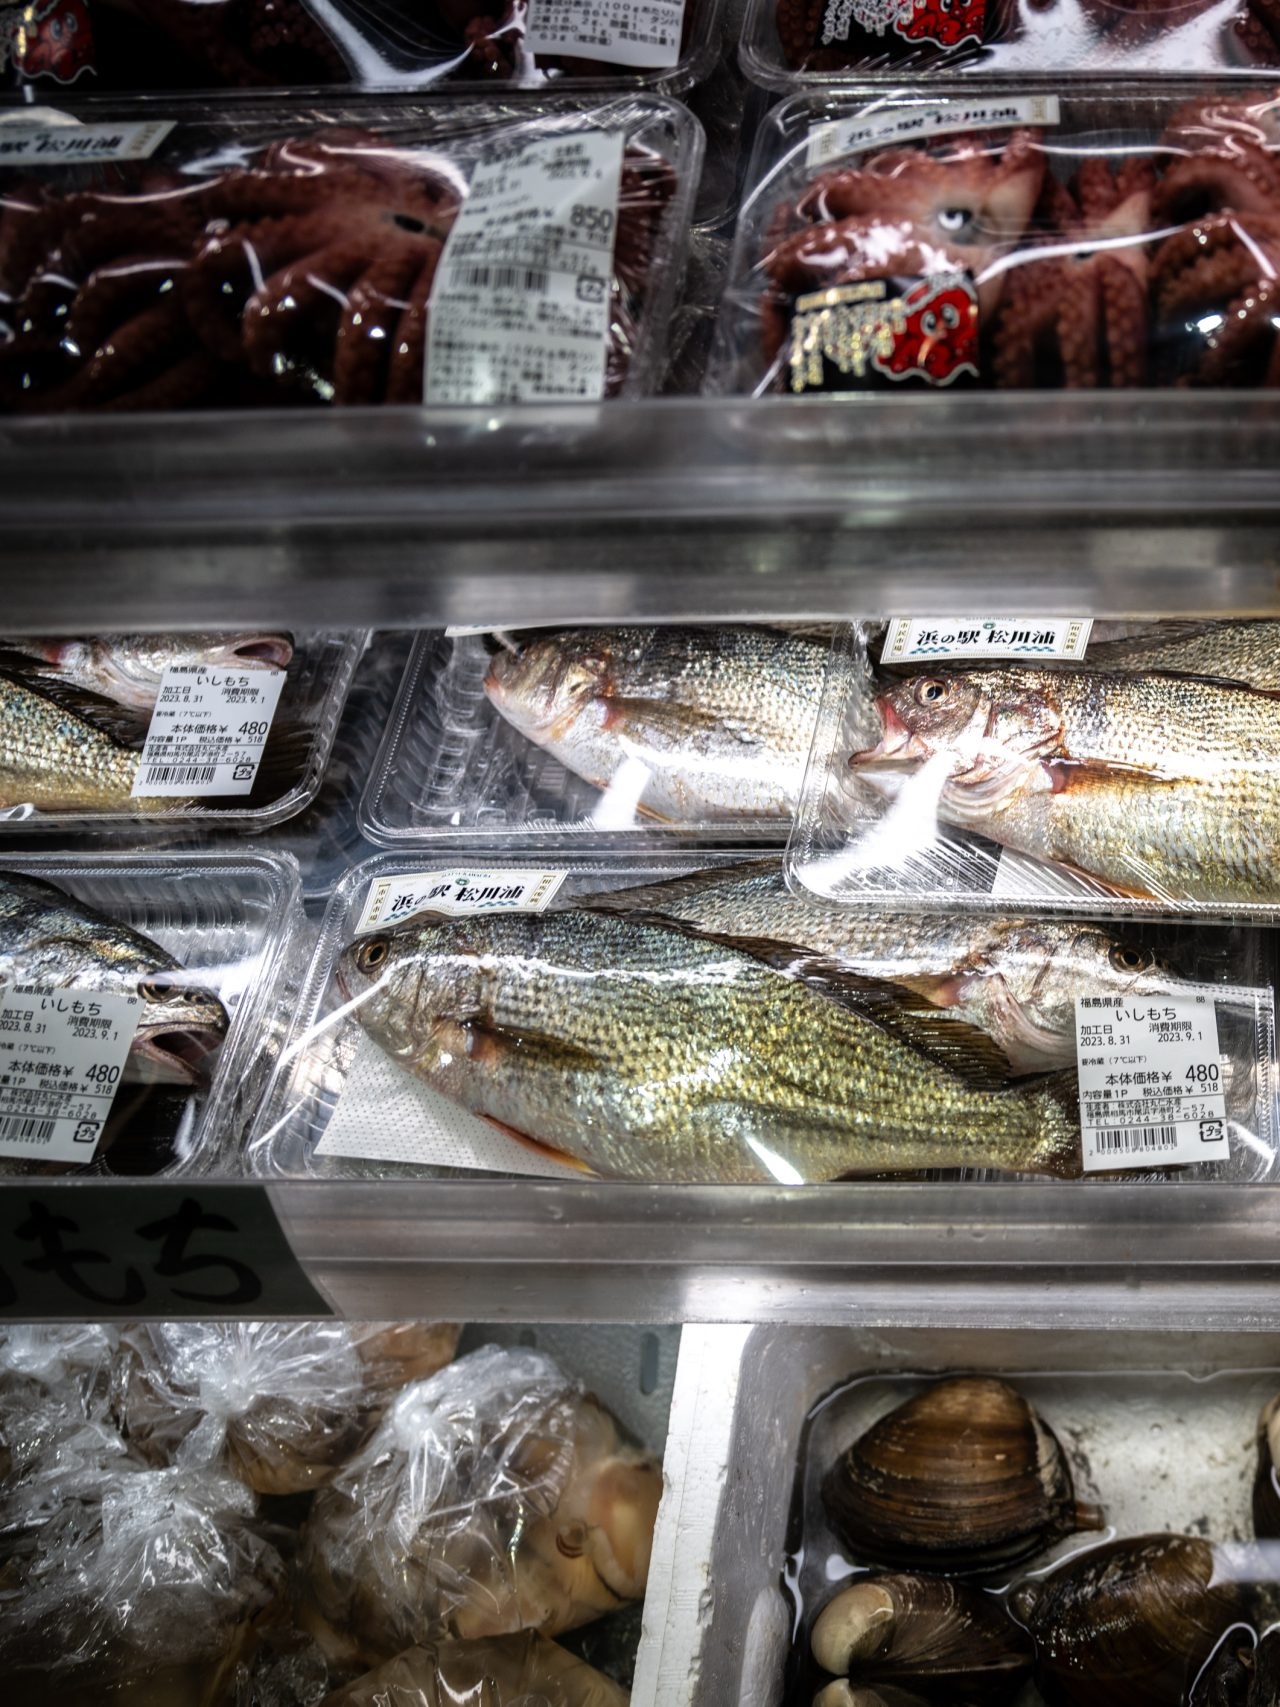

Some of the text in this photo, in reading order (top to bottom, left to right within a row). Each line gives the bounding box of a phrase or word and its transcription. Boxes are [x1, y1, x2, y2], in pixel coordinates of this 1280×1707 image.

[570, 204, 614, 230] 850
[917, 630, 1056, 645] 浜の駅 松川浦
[197, 677, 249, 686] いしもち
[238, 722, 268, 735] 480
[392, 885, 525, 912] 浜の駅 松川浦
[41, 999, 102, 1016] いしもち
[1116, 1007, 1177, 1022] いしもち
[1081, 1022, 1192, 1035] 加工日 消費期限
[86, 1064, 120, 1084] 480
[1105, 1064, 1219, 1086] 本体価格¥ 480
[95, 1085, 113, 1094] 518
[1201, 1083, 1219, 1092] 518
